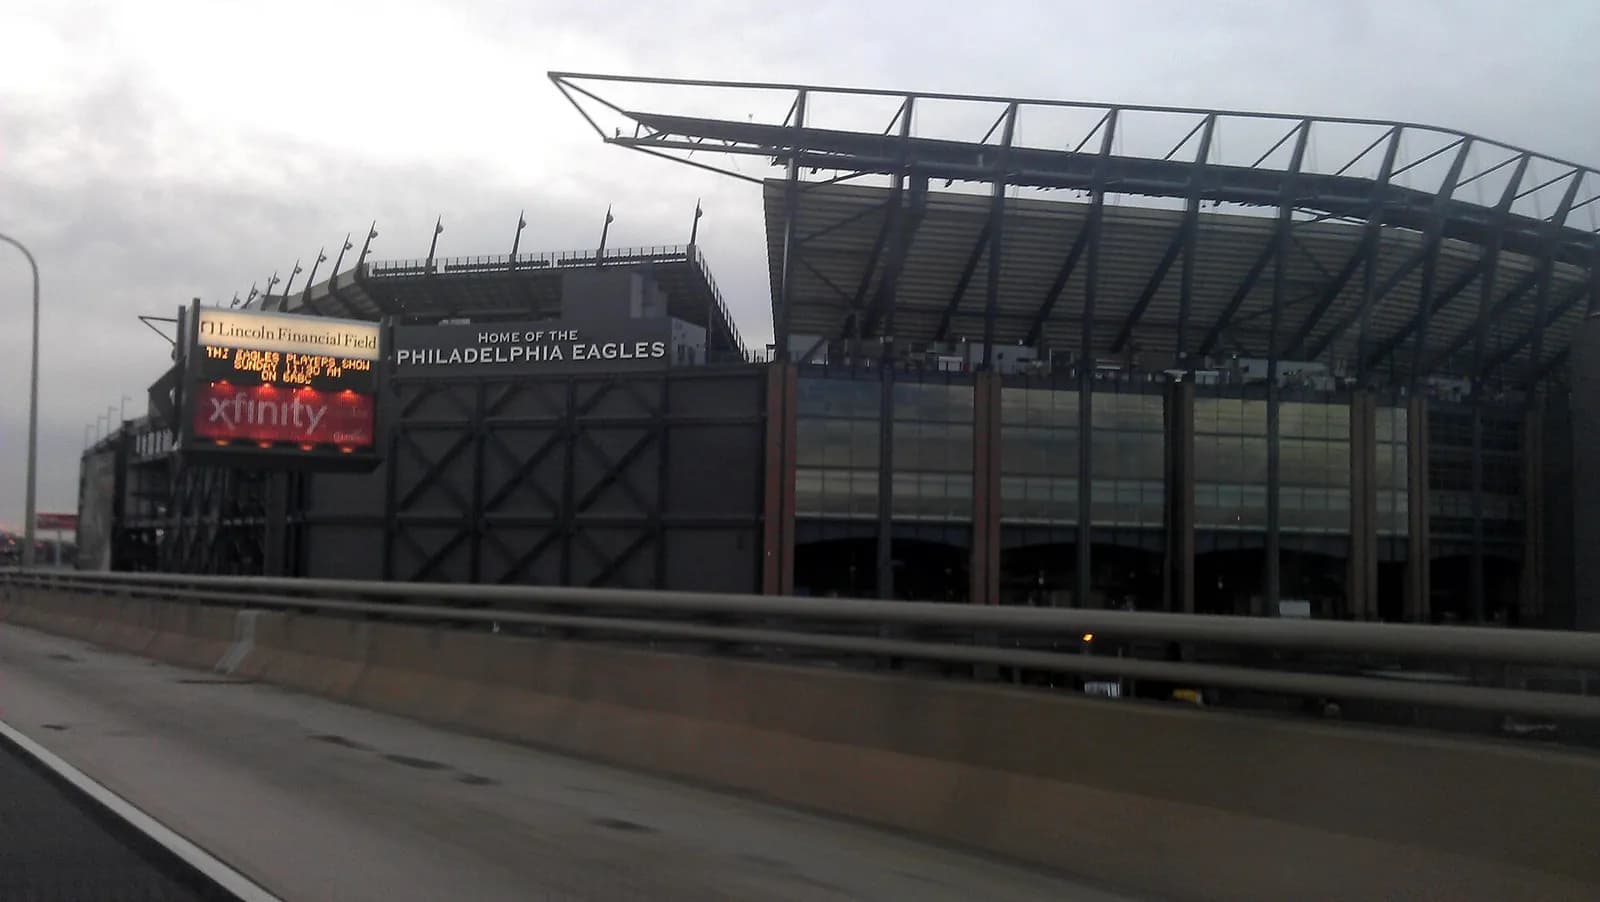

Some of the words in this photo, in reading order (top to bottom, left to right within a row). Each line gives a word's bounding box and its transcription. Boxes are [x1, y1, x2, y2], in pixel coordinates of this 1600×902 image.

[219, 321, 275, 340] Lincoln
[278, 327, 341, 346] Financial
[344, 333, 377, 349] Field
[478, 331, 520, 344] HOME
[525, 331, 544, 342] OF
[549, 330, 578, 341] THE
[397, 346, 563, 365] PHILADELPHIA
[572, 342, 665, 360] EAGLES
[208, 392, 328, 435] xfinity
